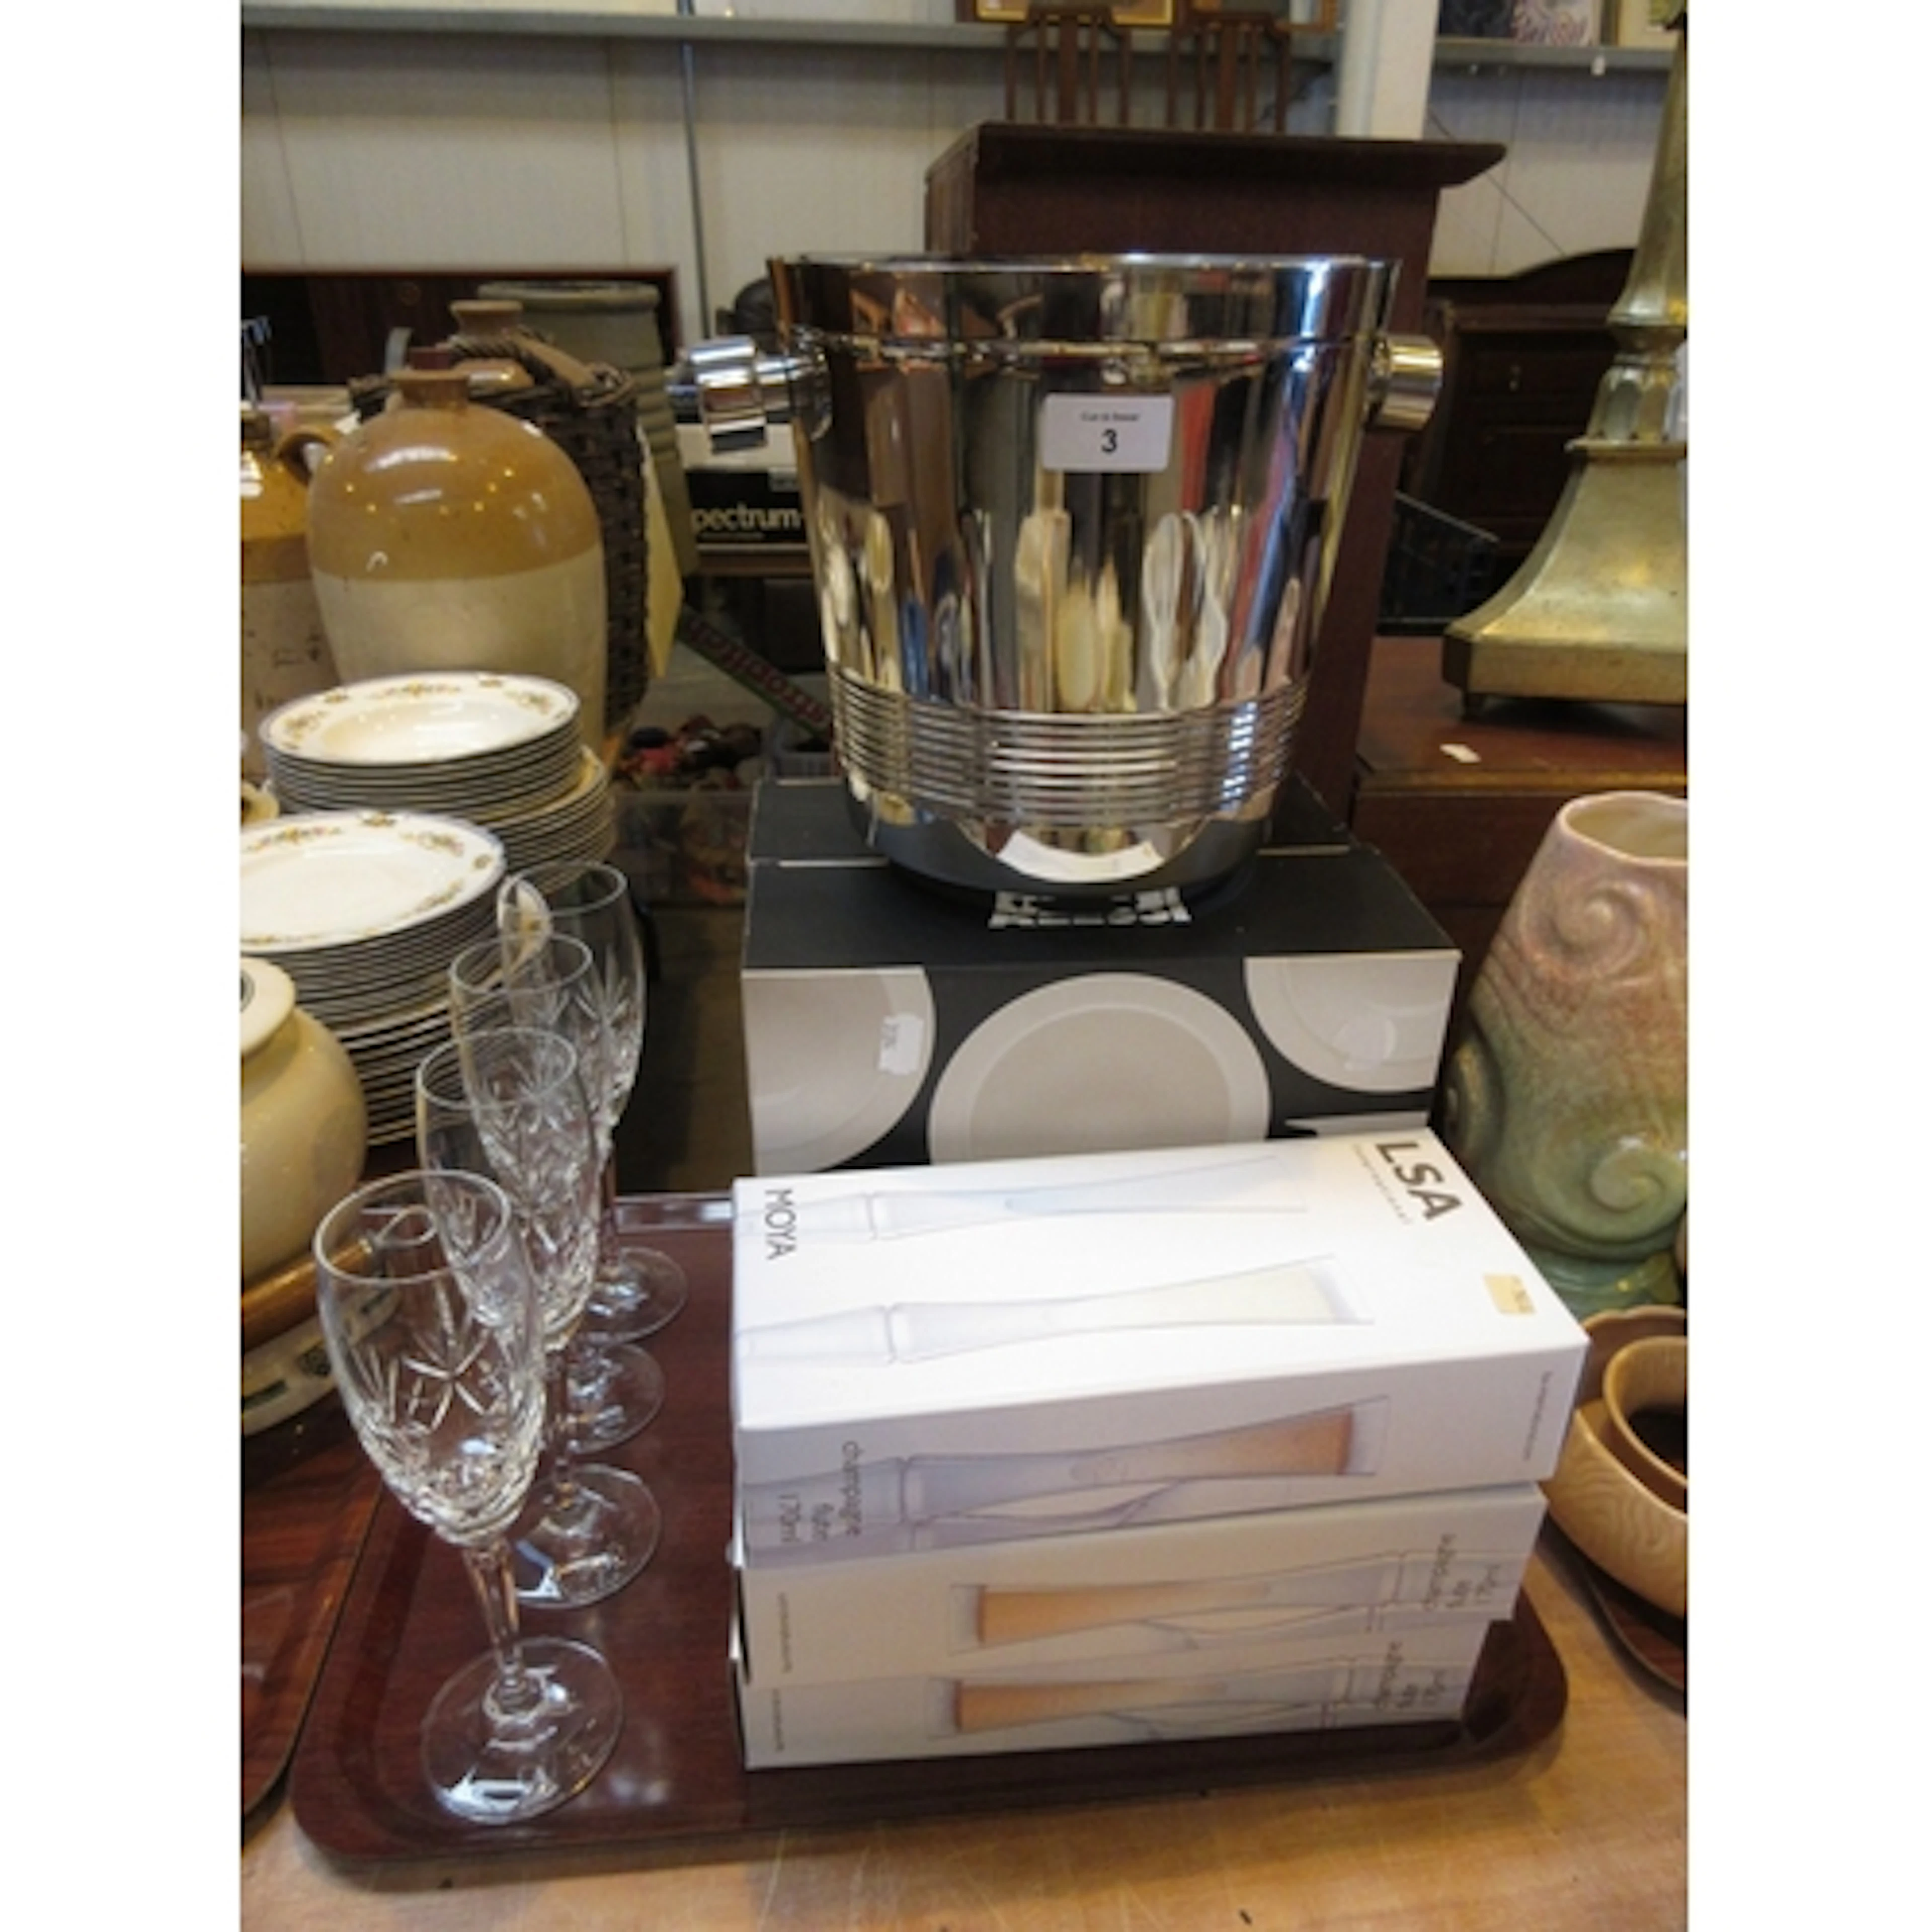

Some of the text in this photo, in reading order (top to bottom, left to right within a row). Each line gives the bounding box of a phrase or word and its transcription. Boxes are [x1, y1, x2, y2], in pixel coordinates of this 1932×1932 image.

[1101, 428, 1118, 453] 3
[691, 502, 801, 534] pectrum
[1375, 1139, 1464, 1222] LSA
[765, 1188, 797, 1260] MOYA
[838, 1439, 865, 1536] champagne
